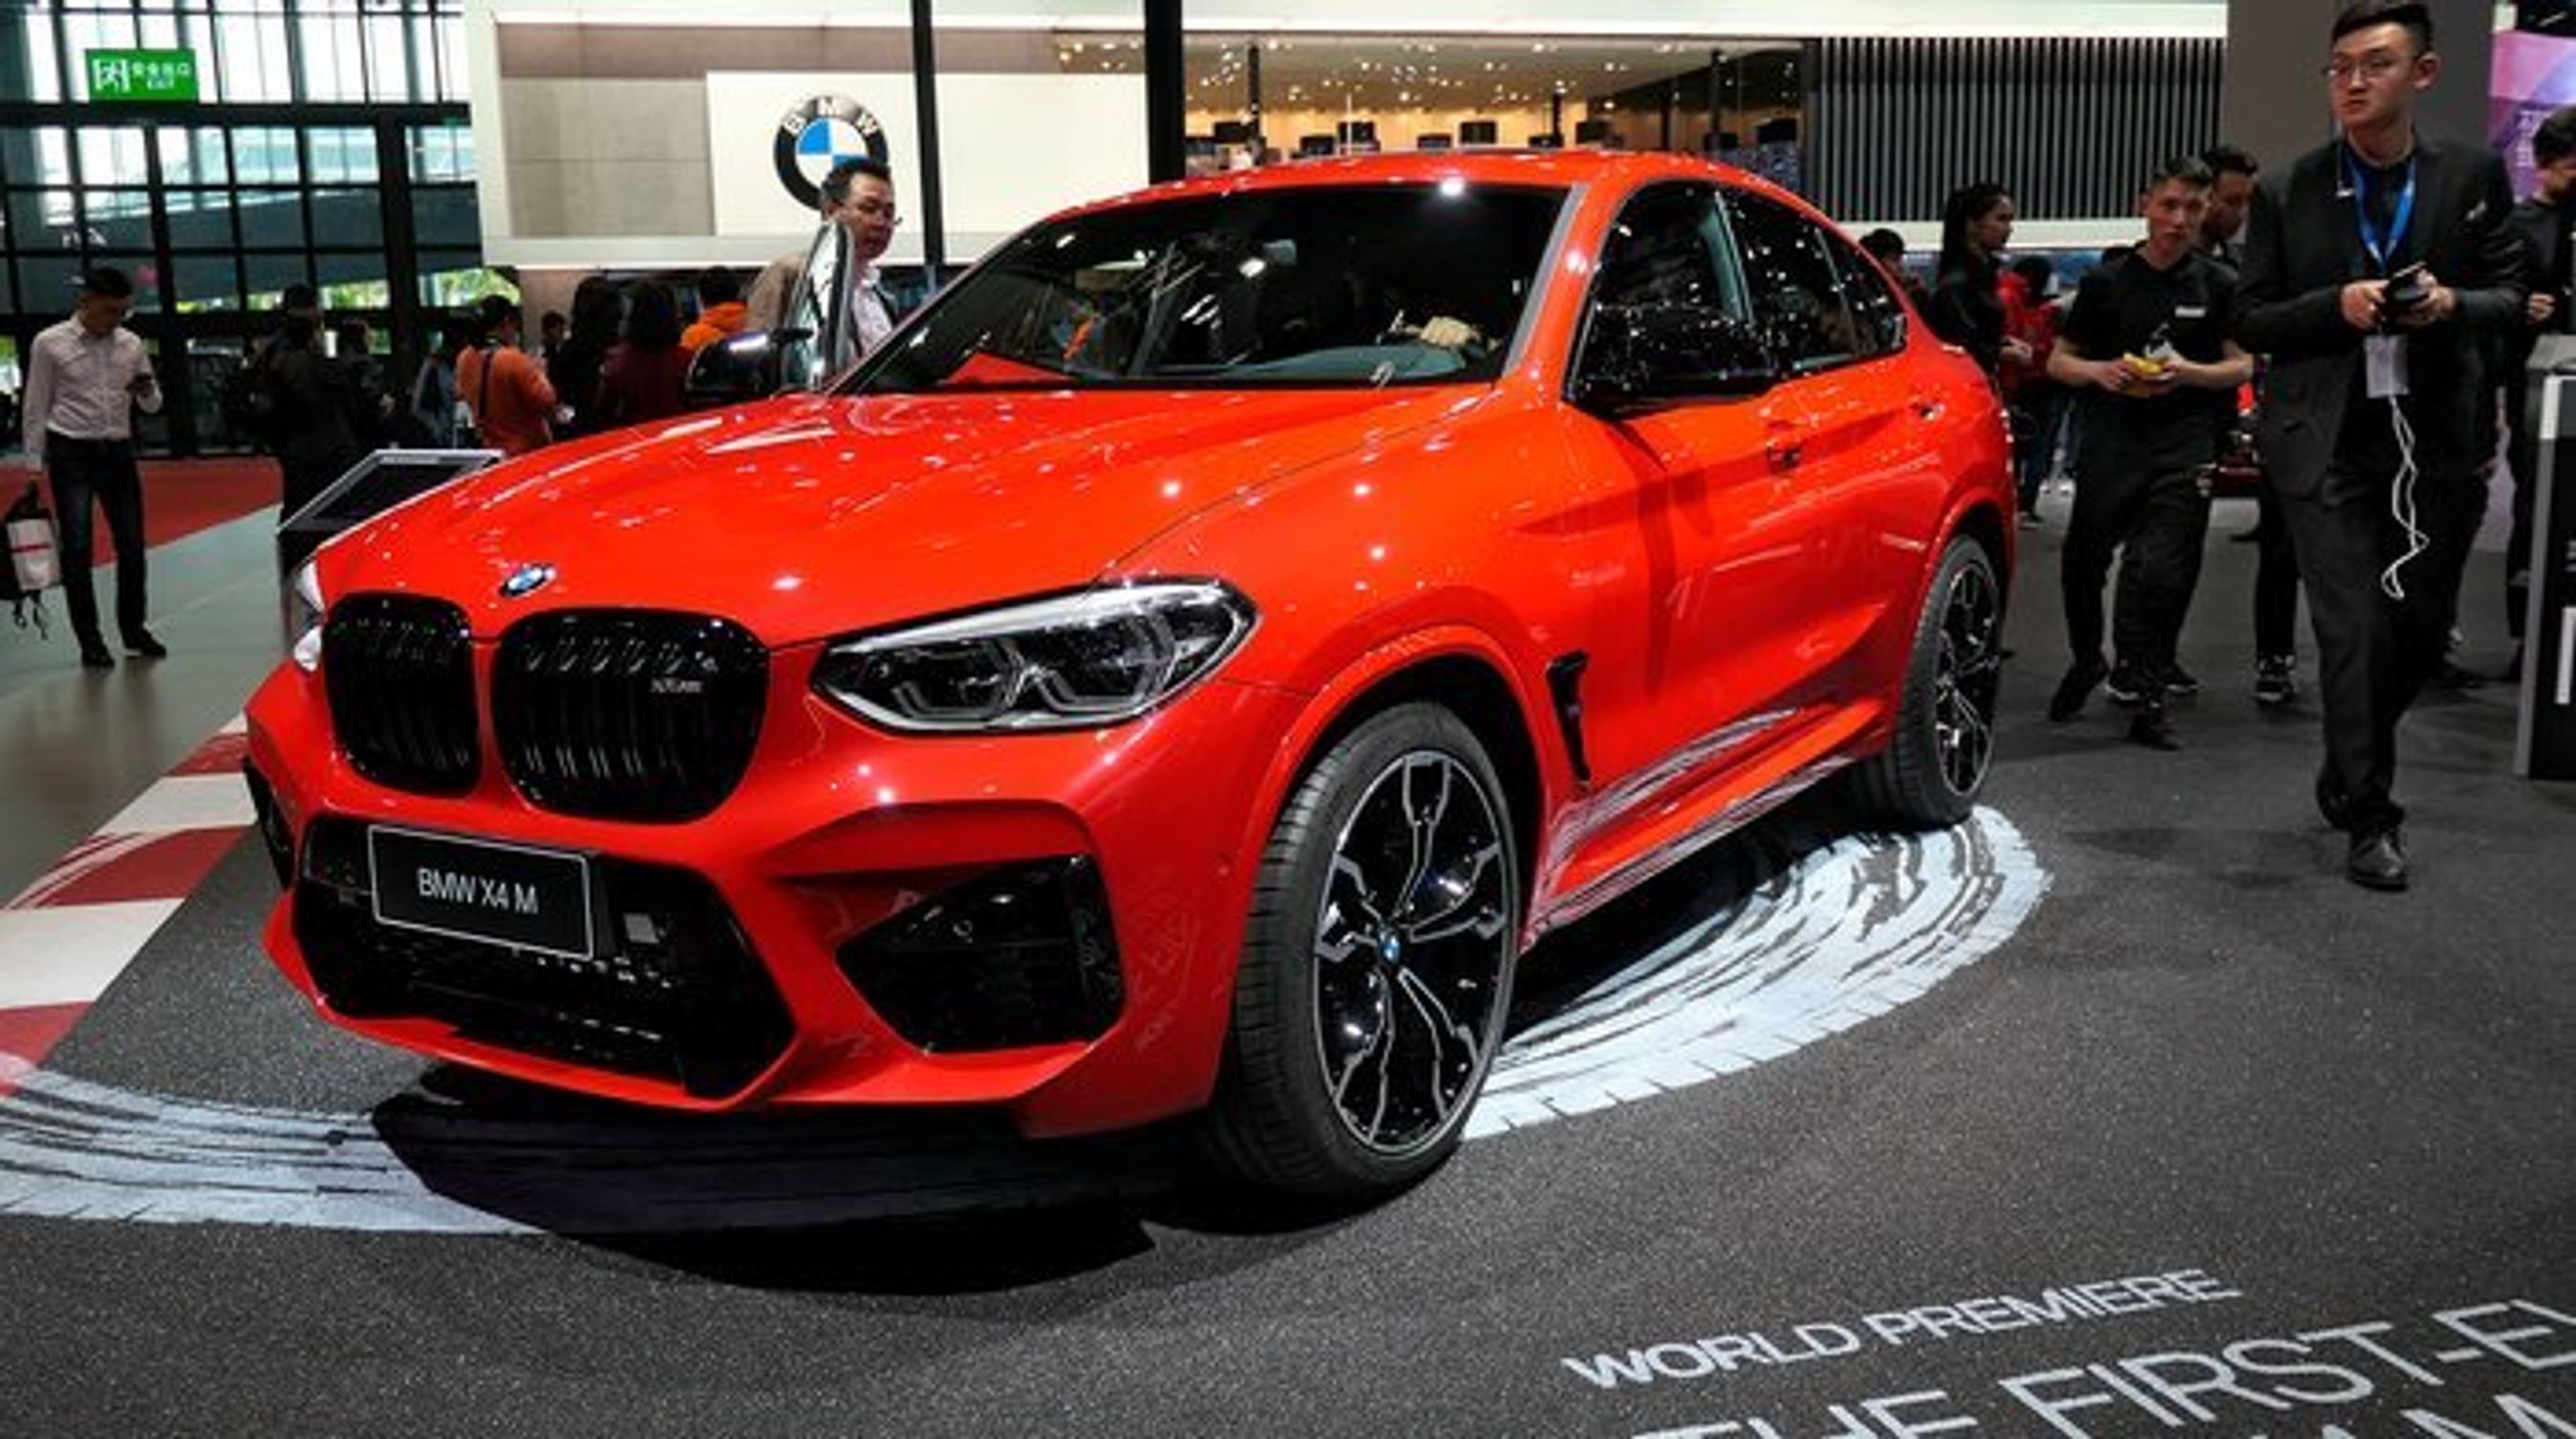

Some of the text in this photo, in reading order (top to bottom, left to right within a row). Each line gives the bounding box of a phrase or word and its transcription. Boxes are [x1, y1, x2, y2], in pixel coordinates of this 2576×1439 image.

[418, 867, 539, 914] BMW X4 M
[1560, 1268, 2243, 1388] WORLD PREMIERE
